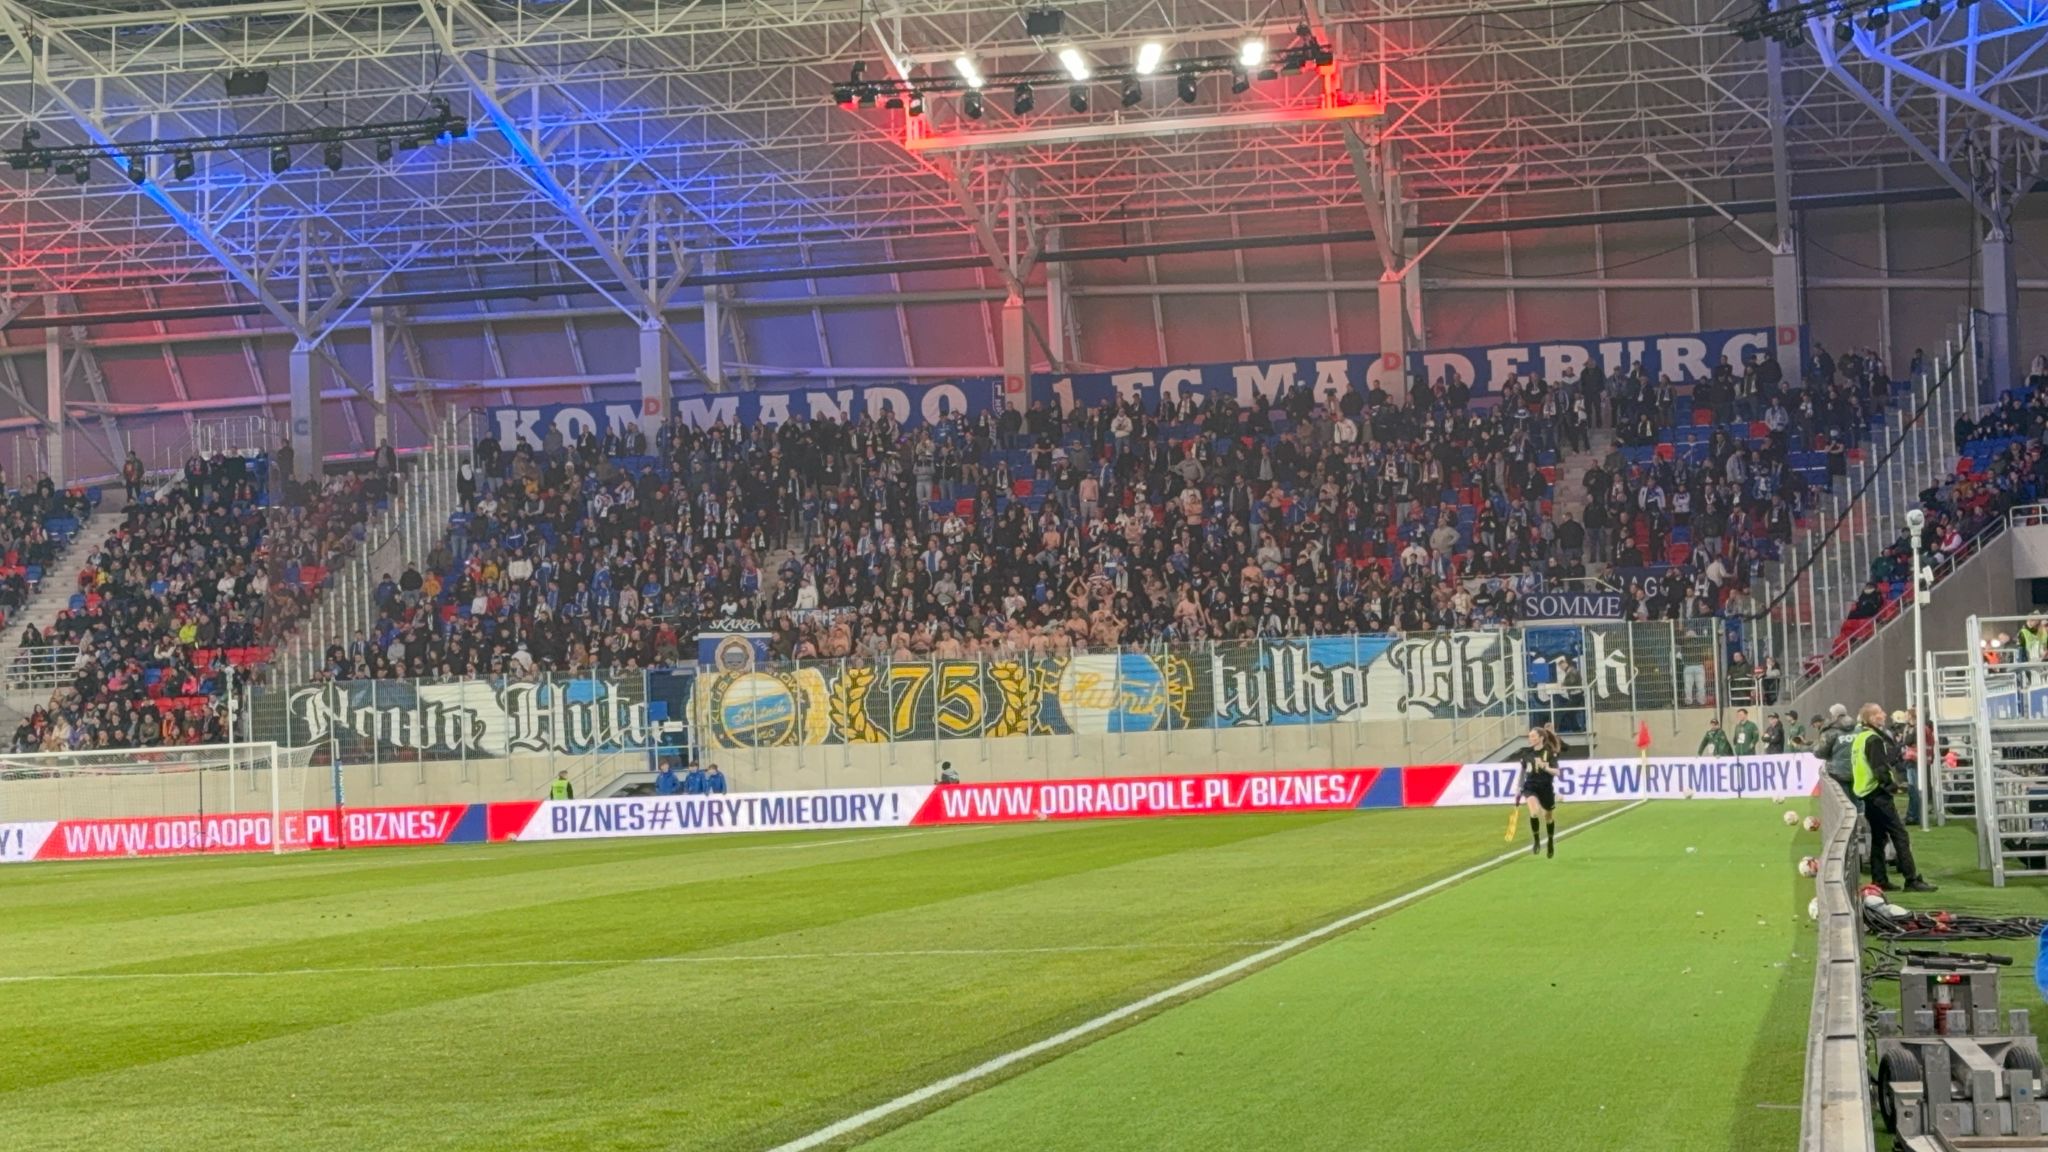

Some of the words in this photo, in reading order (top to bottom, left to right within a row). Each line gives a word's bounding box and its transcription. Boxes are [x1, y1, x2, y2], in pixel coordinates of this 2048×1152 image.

[1778, 327, 1796, 345] D
[1383, 353, 1401, 371] D
[1007, 376, 1024, 393] D
[644, 397, 660, 416] D
[1525, 595, 1621, 618] SOMME
[882, 663, 985, 736] 75
[1205, 645, 1365, 727] tylko
[1473, 761, 1804, 799] BIZS#WRYTMIEODRY!
[942, 775, 1361, 817] WWW.ODRAOPOLE.PL/BIZNES/
[64, 811, 450, 853] WWW.ODRAOPOE.PLBIZNES/
